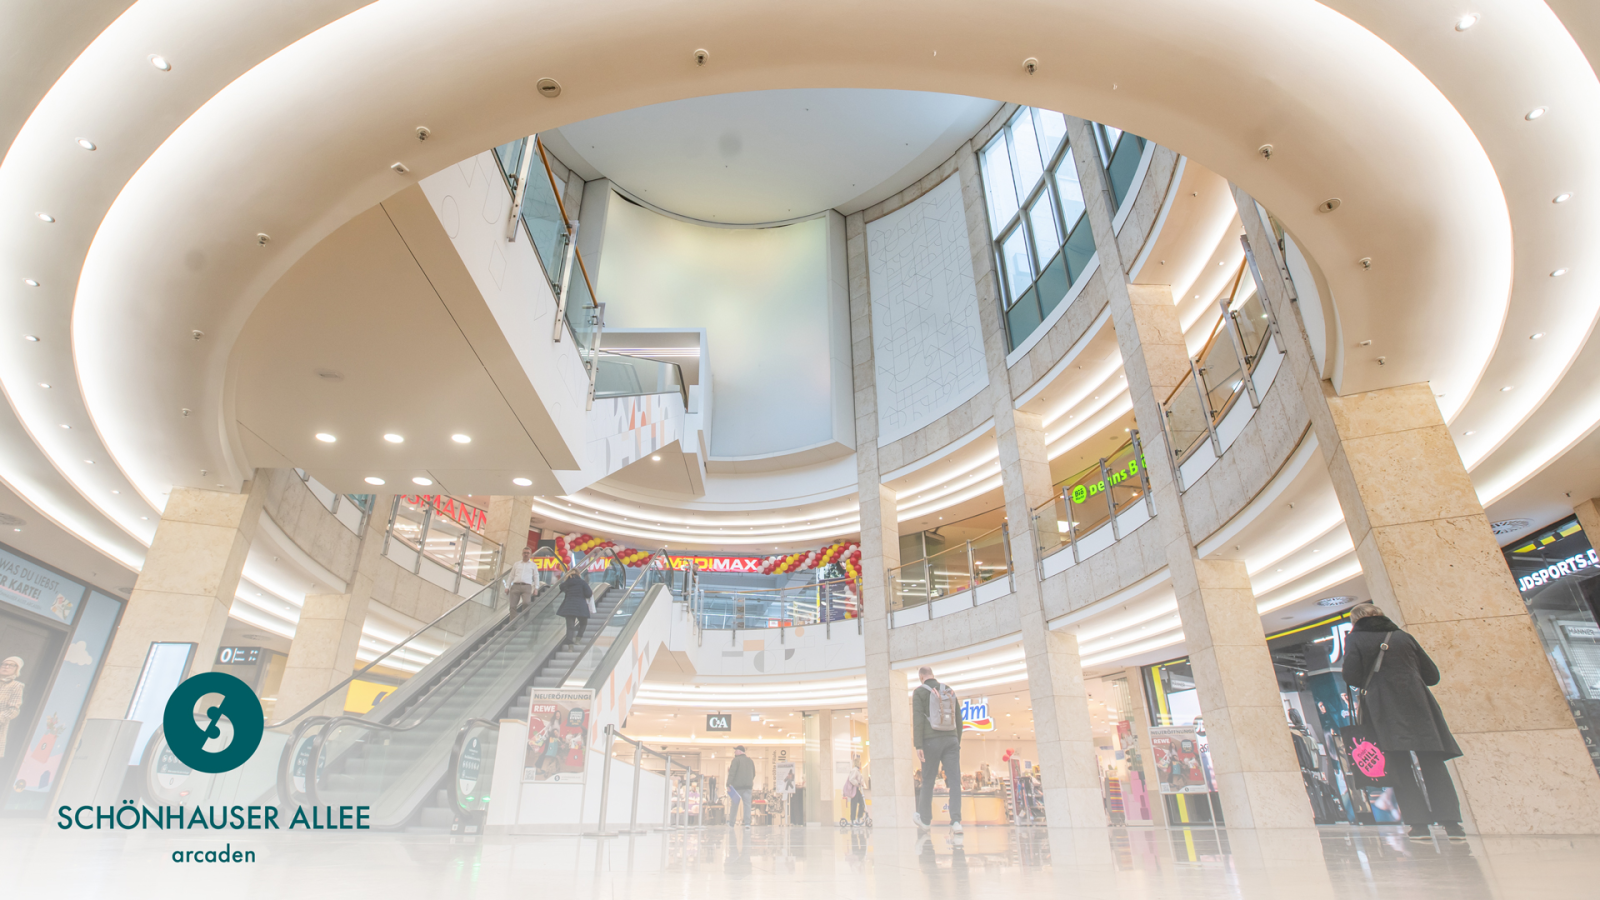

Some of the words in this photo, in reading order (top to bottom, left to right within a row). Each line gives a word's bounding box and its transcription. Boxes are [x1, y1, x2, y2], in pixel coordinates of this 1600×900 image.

[8, 578, 42, 600] KARTE!
[20, 568, 35, 581] DU
[34, 573, 60, 594] LIEBST,
[533, 705, 556, 713] REWE
[961, 700, 987, 720] dm
[1358, 748, 1377, 768] CHILI
[1364, 754, 1380, 772] FEST
